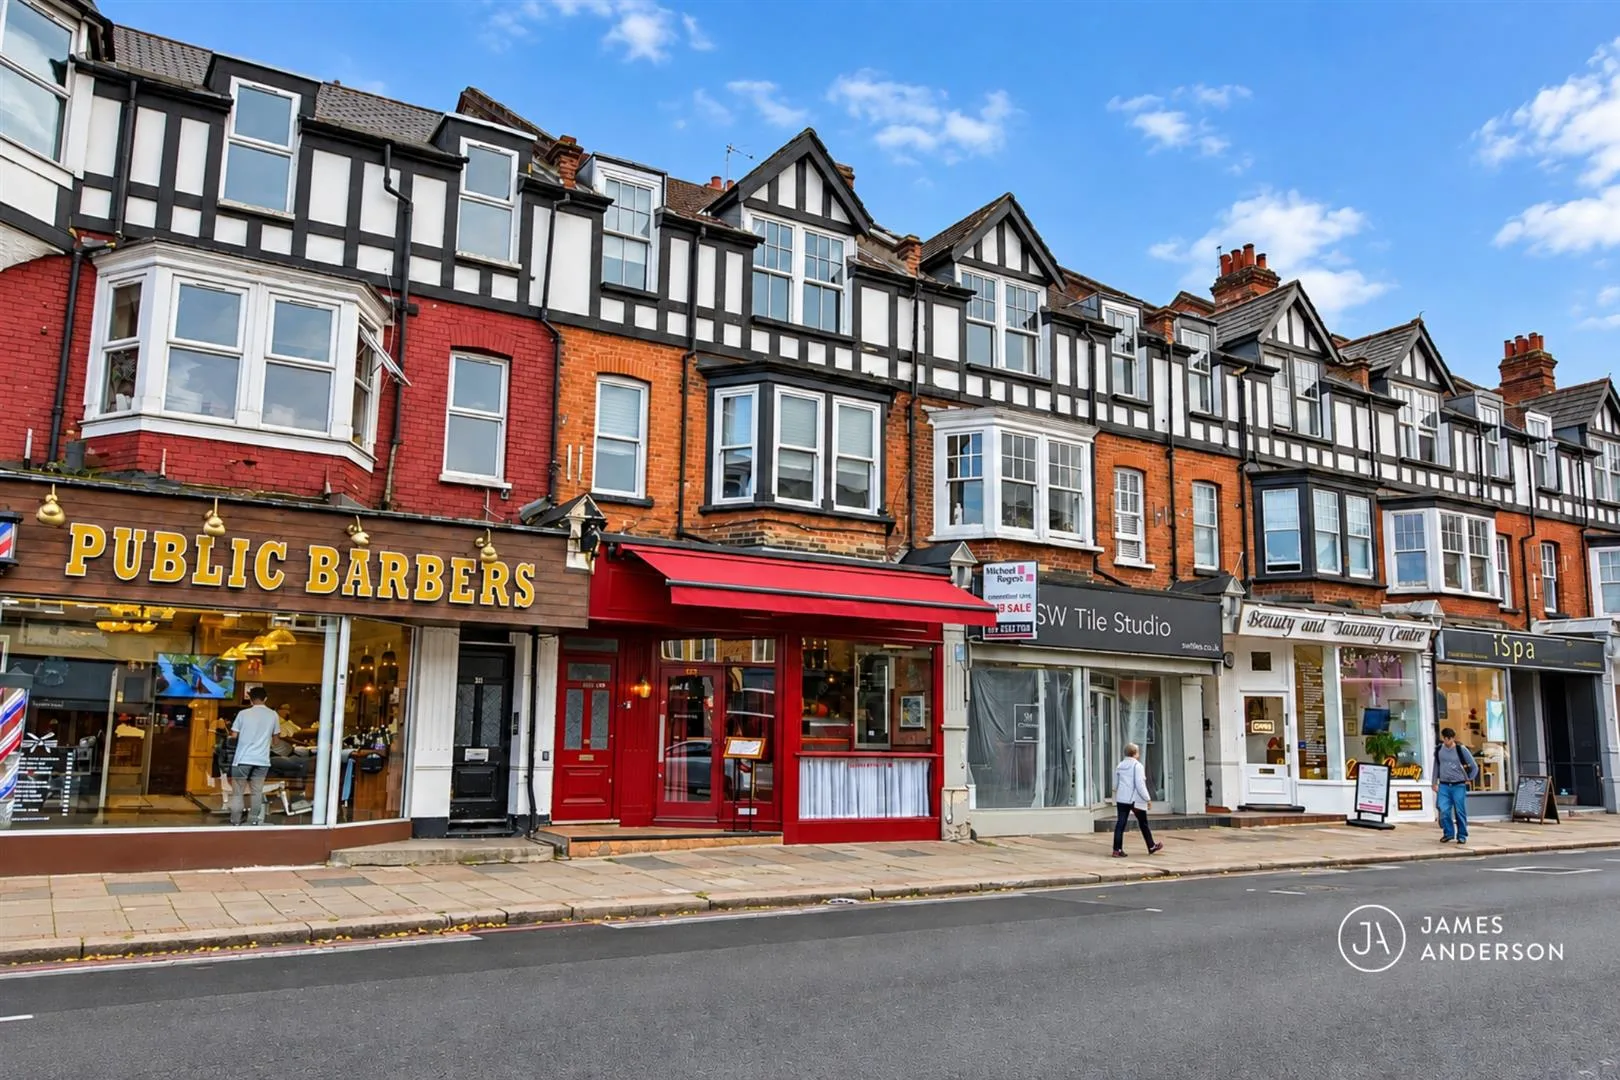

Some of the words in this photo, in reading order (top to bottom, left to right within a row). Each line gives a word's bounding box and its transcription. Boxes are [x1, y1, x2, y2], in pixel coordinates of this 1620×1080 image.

[64, 521, 288, 591] PUBLIC
[305, 544, 536, 609] BARBERS
[1007, 602, 1032, 613] SALE
[1074, 607, 1108, 632] Tile
[1113, 611, 1172, 637] Studio
[1246, 609, 1297, 637] Beauty
[1300, 618, 1327, 633] and
[1331, 620, 1385, 645] Tanning
[1389, 624, 1426, 643] Centre
[1493, 633, 1535, 664] iSpa
